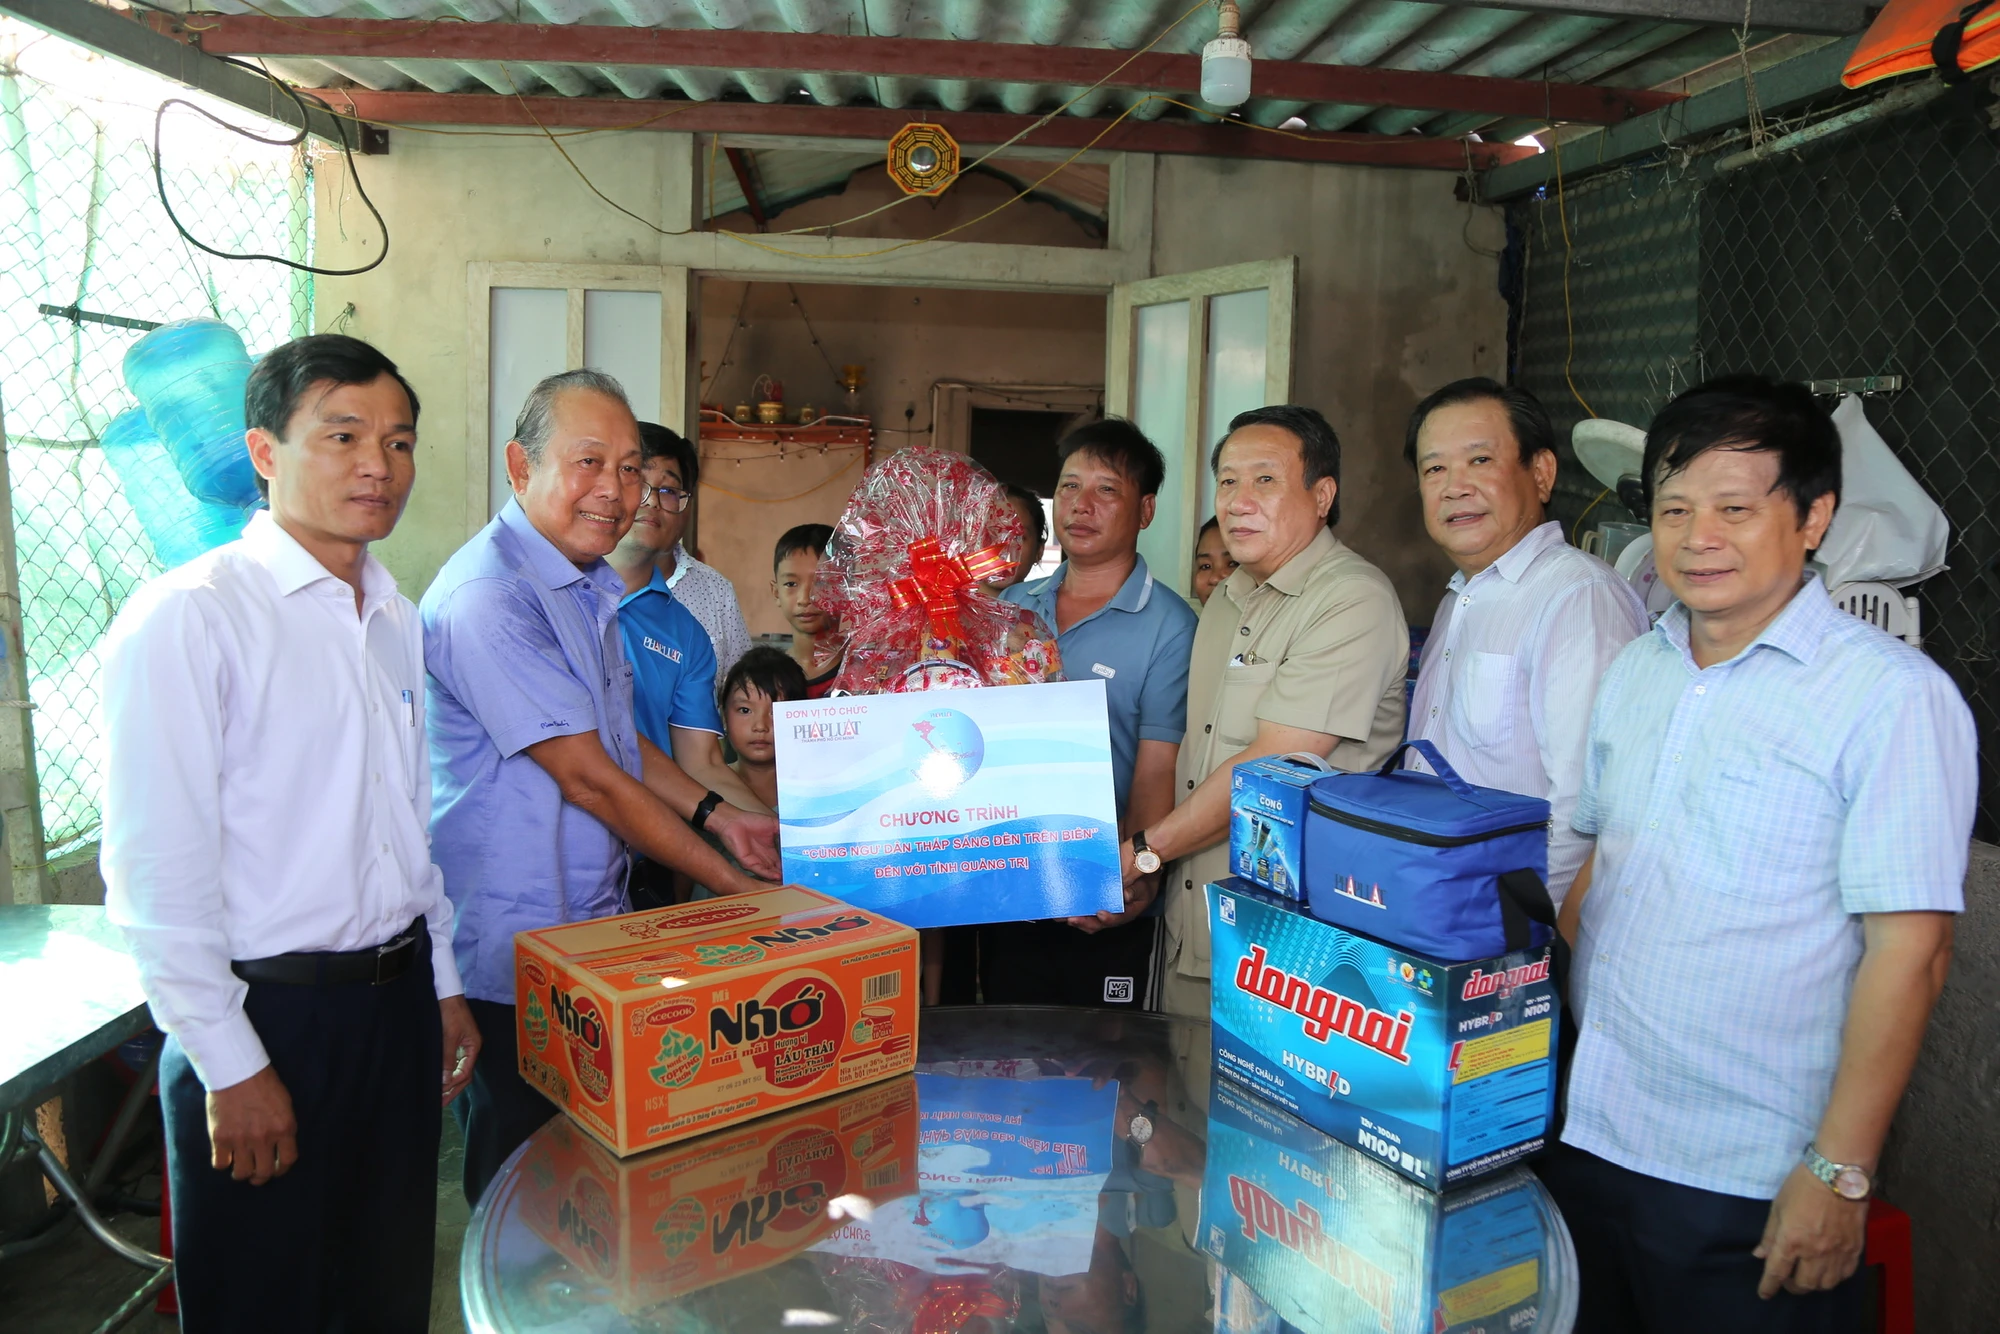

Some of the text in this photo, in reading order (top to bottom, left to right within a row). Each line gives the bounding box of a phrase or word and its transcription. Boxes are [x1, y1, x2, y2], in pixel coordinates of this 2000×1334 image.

[785, 709, 809, 719] ĐƠN
[811, 708, 821, 719] VỊ
[839, 703, 868, 716] CHỨC
[879, 803, 1018, 828] CHƯƠNG TRÌNH
[850, 844, 881, 857] NGƯ
[884, 841, 911, 855] DÂN
[953, 834, 990, 850] SÁNG
[993, 831, 1021, 846] ĐÈN
[1024, 828, 1059, 844] TRÊN
[904, 863, 927, 877] VỚI
[1008, 856, 1029, 870] TRỊ
[750, 914, 872, 948] Nhớ
[645, 995, 696, 1014] Cook happiness
[1524, 1001, 1551, 1018] N100
[550, 982, 601, 1050] Nhớ
[708, 982, 826, 1052] Nhớ
[774, 1032, 809, 1050] Hương vị
[710, 1042, 769, 1066] mãi mãi
[774, 1039, 835, 1067] LẨU THÁI
[869, 1057, 884, 1067] 36%
[659, 1055, 701, 1084] TOPPING
[675, 1070, 692, 1083] HƠN
[774, 1057, 824, 1076] Noodles Thai
[774, 1061, 835, 1084] Hotpot Flavour
[839, 1073, 853, 1084] tinh
[854, 1069, 865, 1080] bột
[1218, 1047, 1285, 1087] CÔNG NGHỆ CHÂU ÂU
[717, 1085, 725, 1093] 27
[645, 1096, 668, 1112] NSX:
[1445, 1167, 1462, 1179] CÔNG
